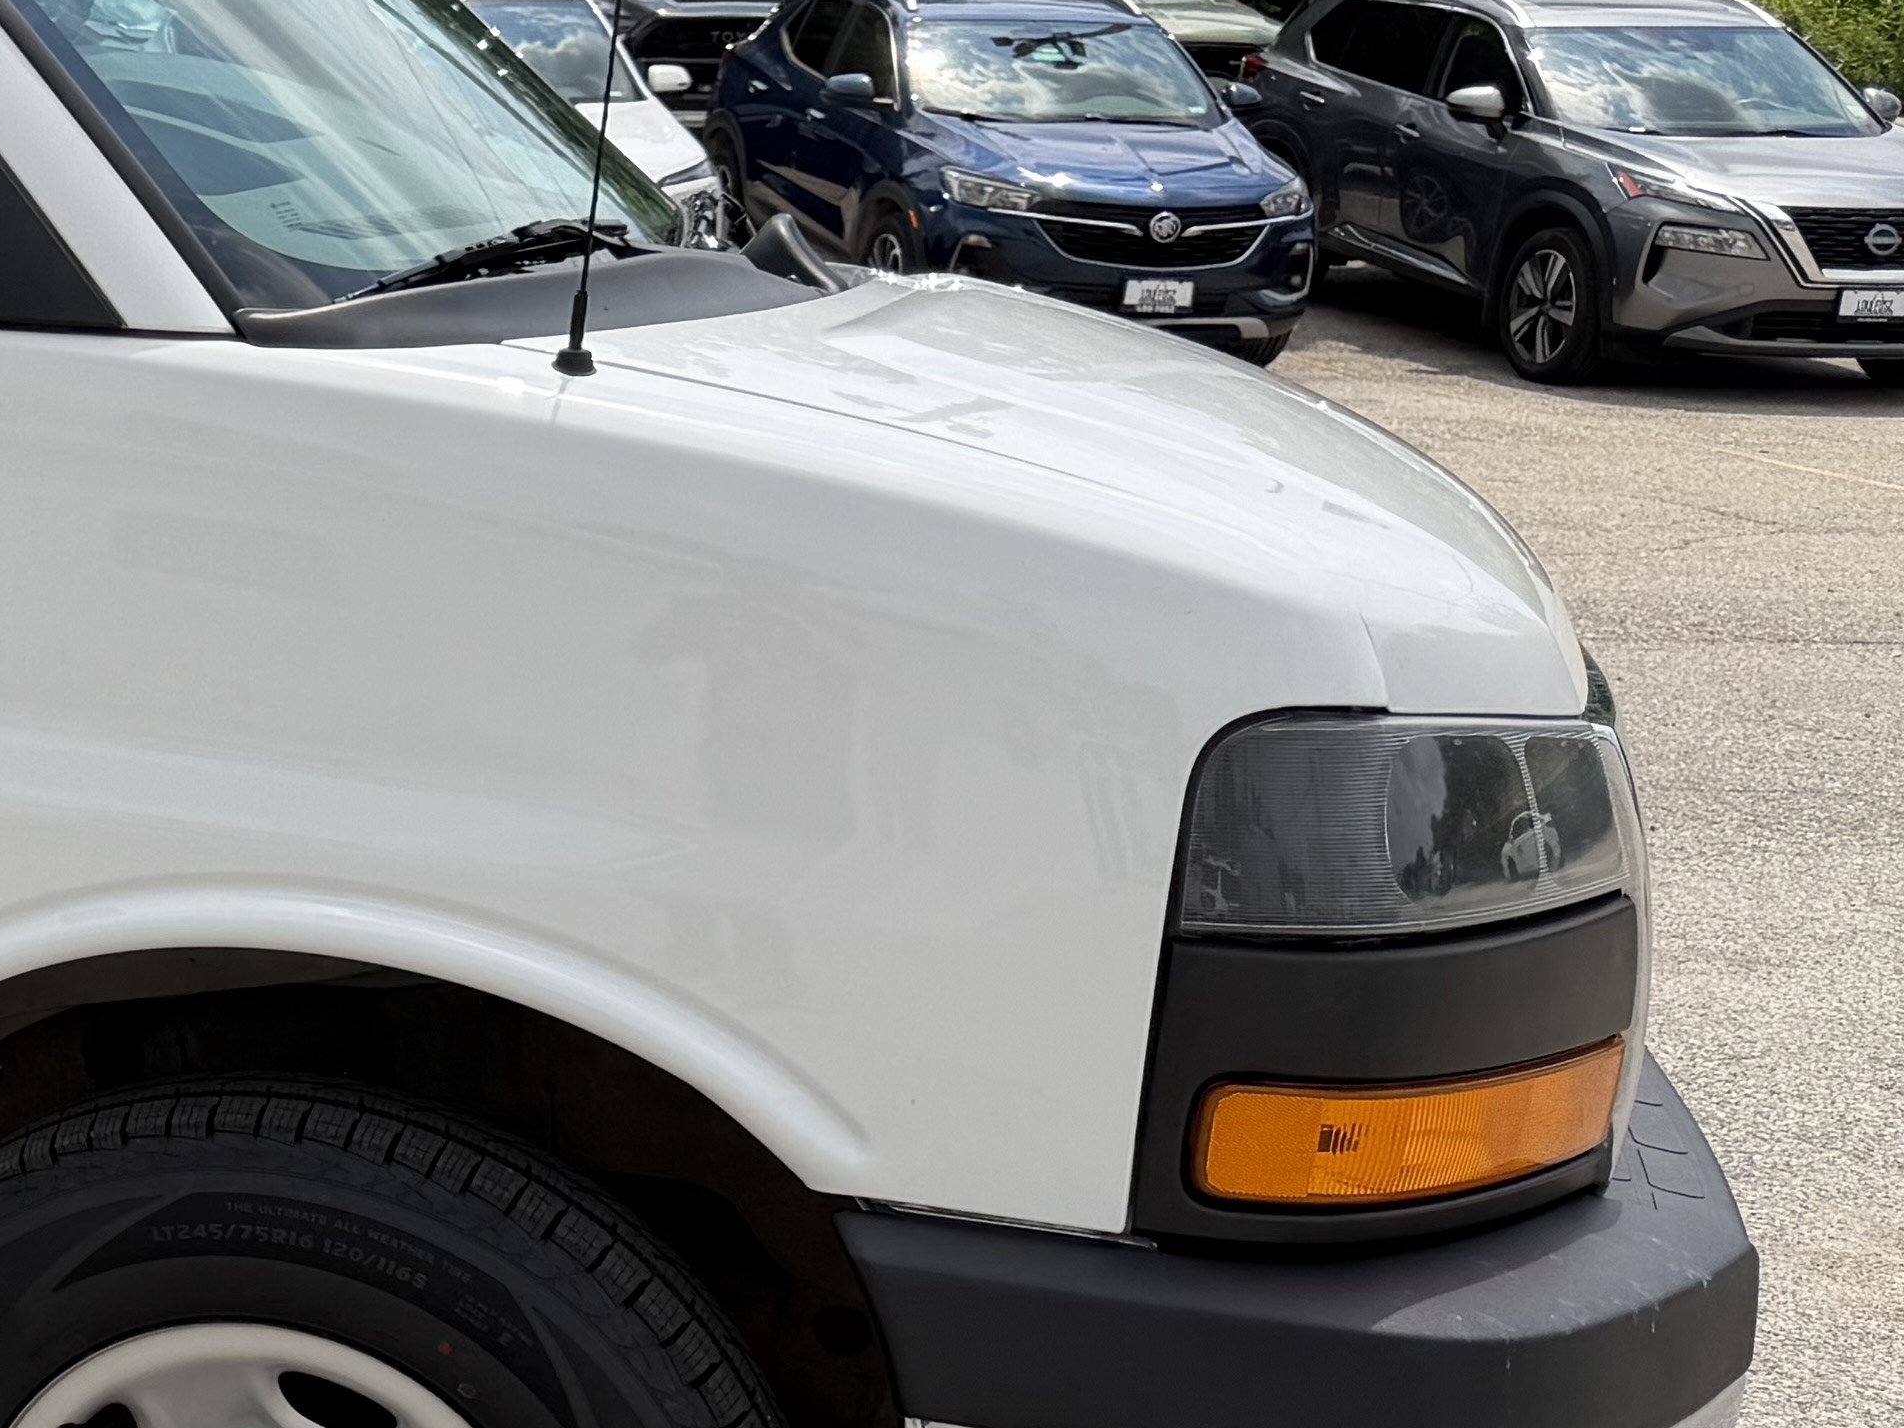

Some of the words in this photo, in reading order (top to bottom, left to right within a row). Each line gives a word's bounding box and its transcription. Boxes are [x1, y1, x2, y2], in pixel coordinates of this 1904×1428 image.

[224, 1199, 255, 1215] THE
[256, 1203, 329, 1227] ULTIMATE
[332, 1217, 361, 1236] ALL
[149, 1223, 317, 1251] LT245/75R16
